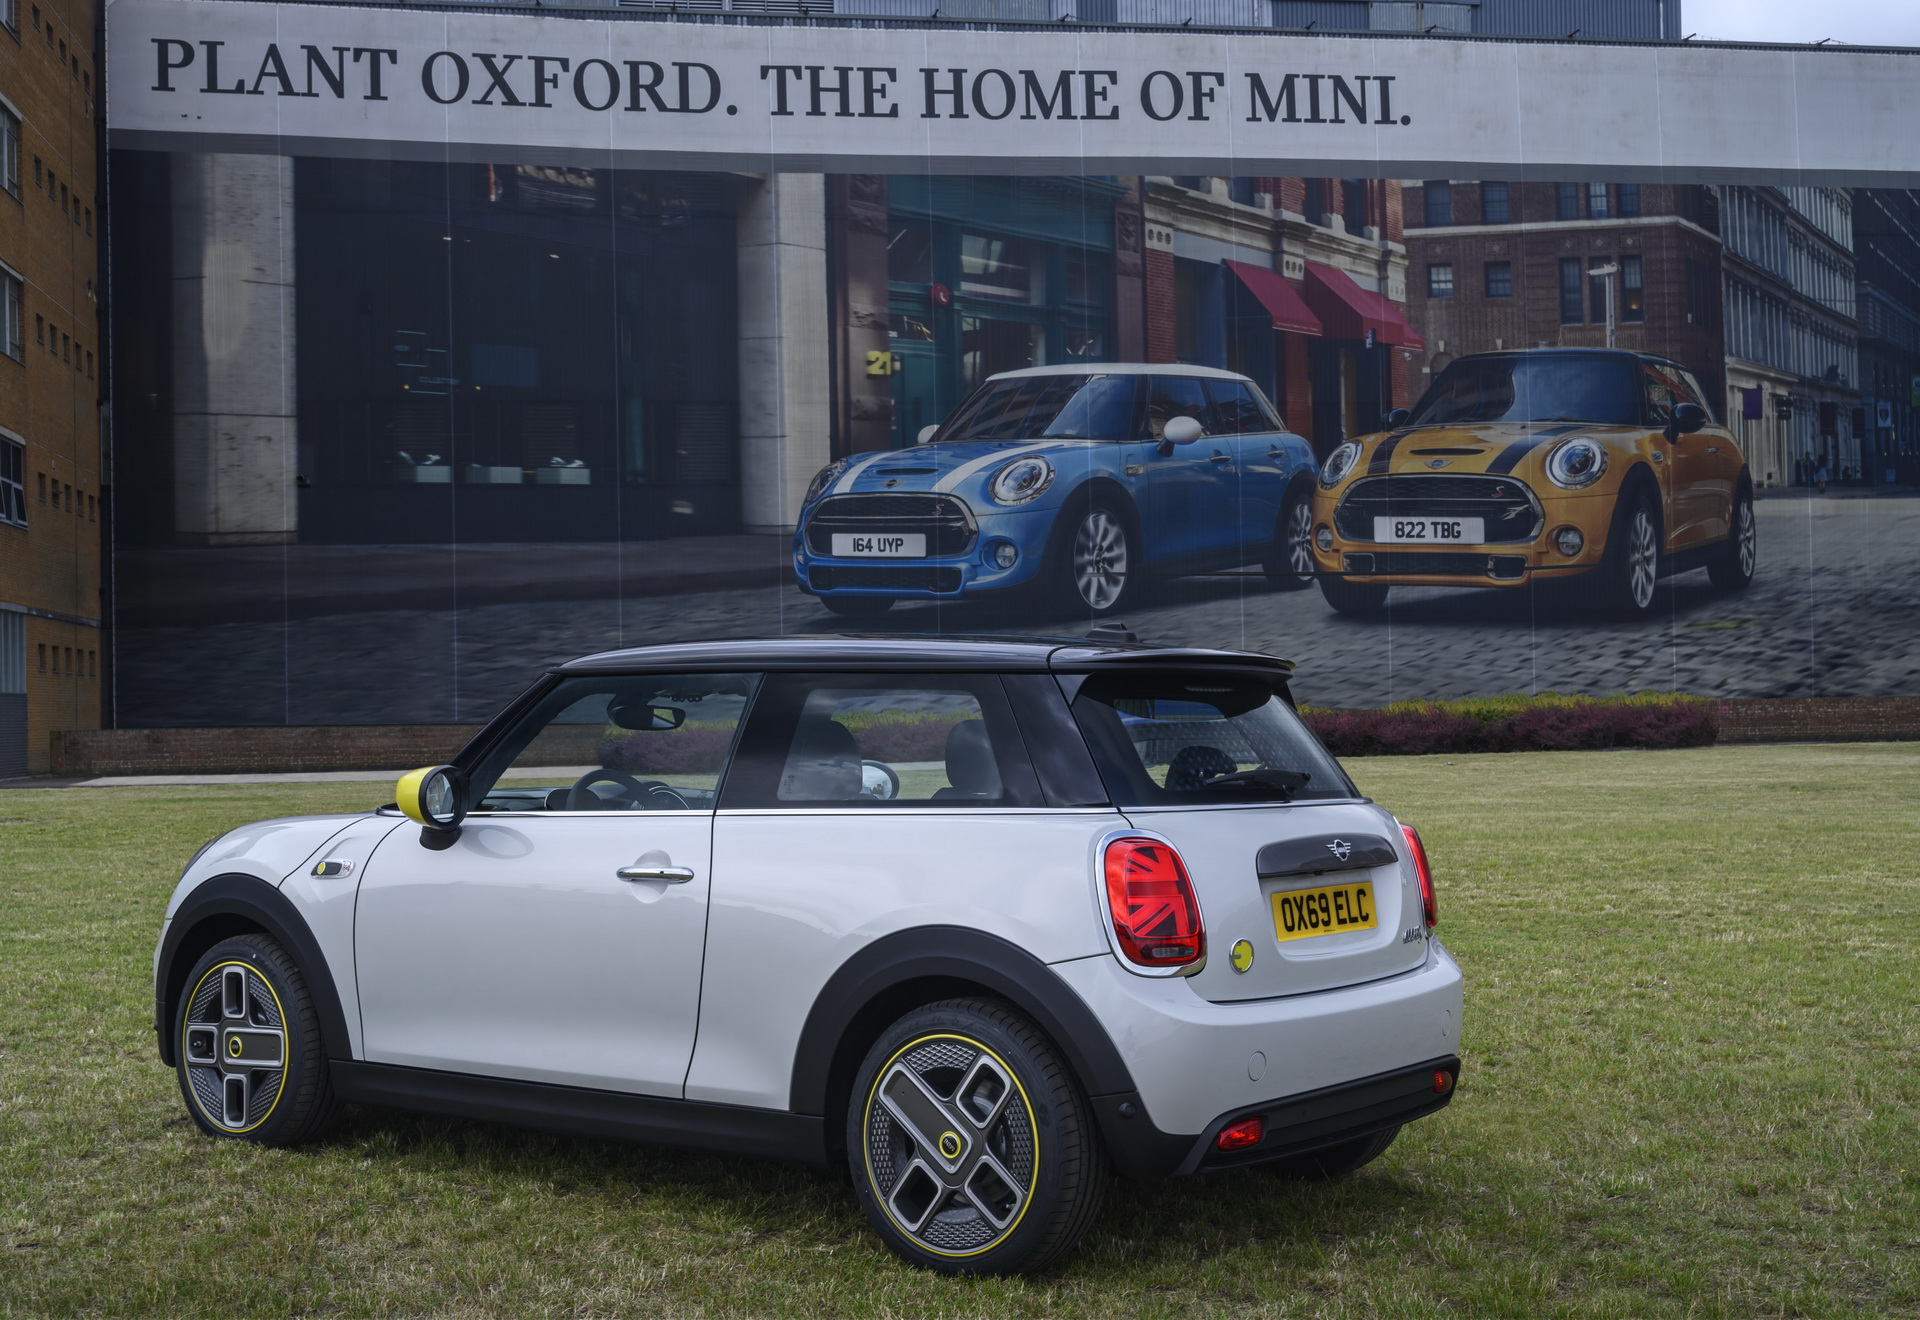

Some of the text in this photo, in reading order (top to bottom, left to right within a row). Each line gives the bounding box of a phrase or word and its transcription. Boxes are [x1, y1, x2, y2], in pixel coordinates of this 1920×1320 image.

[150, 38, 1411, 126] PLANT OXFORD. THE HOME OF MINI.
[866, 350, 892, 376] 21
[1394, 521, 1462, 539] 822 TBG
[852, 537, 904, 553] 164 UYP
[1281, 888, 1370, 932] OX69 ELC
